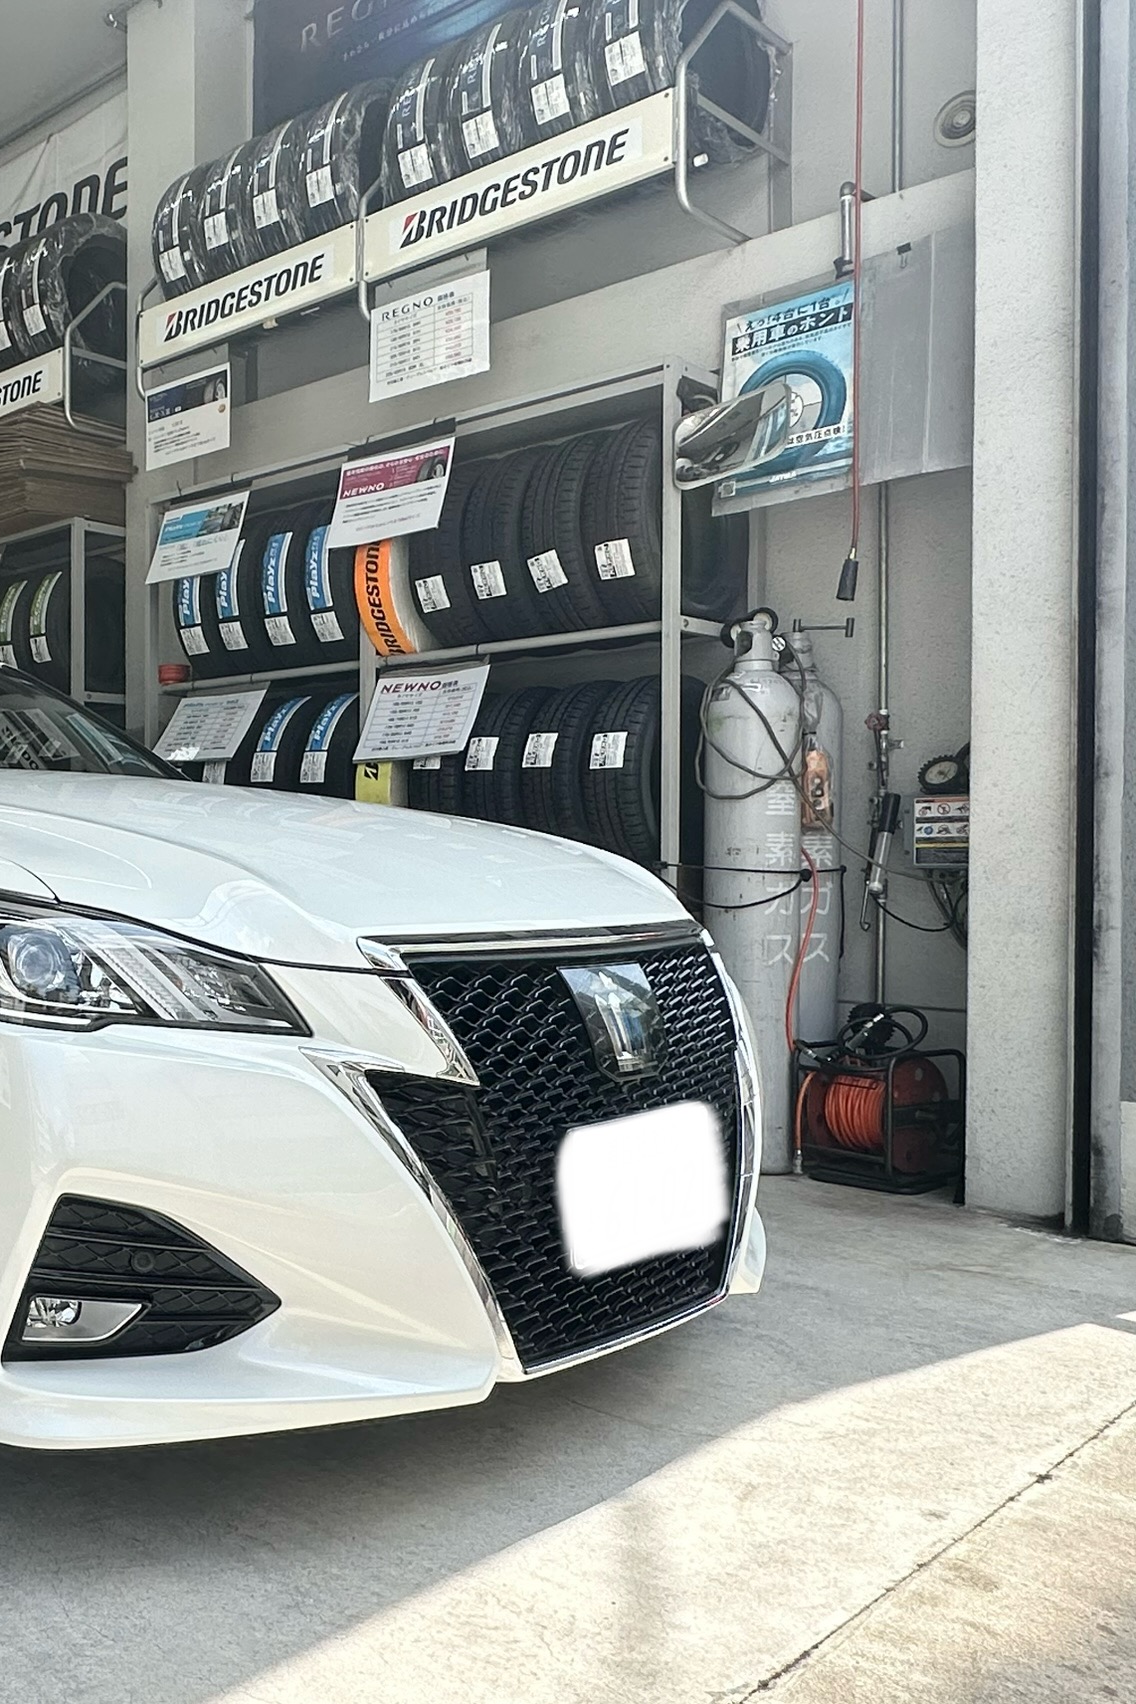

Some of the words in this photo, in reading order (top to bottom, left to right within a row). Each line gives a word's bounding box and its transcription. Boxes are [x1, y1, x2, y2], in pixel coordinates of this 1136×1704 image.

[399, 128, 630, 249] BRIDGESTONE
[163, 253, 325, 342] BRIDGESTONE
[381, 296, 434, 322] REGNO
[735, 306, 849, 353] 乗用車のホント
[342, 482, 385, 498] NEWNO
[182, 577, 191, 616] Play
[218, 570, 228, 608] Play
[366, 541, 406, 655] RIDGESTON
[380, 680, 442, 694] NEWNO
